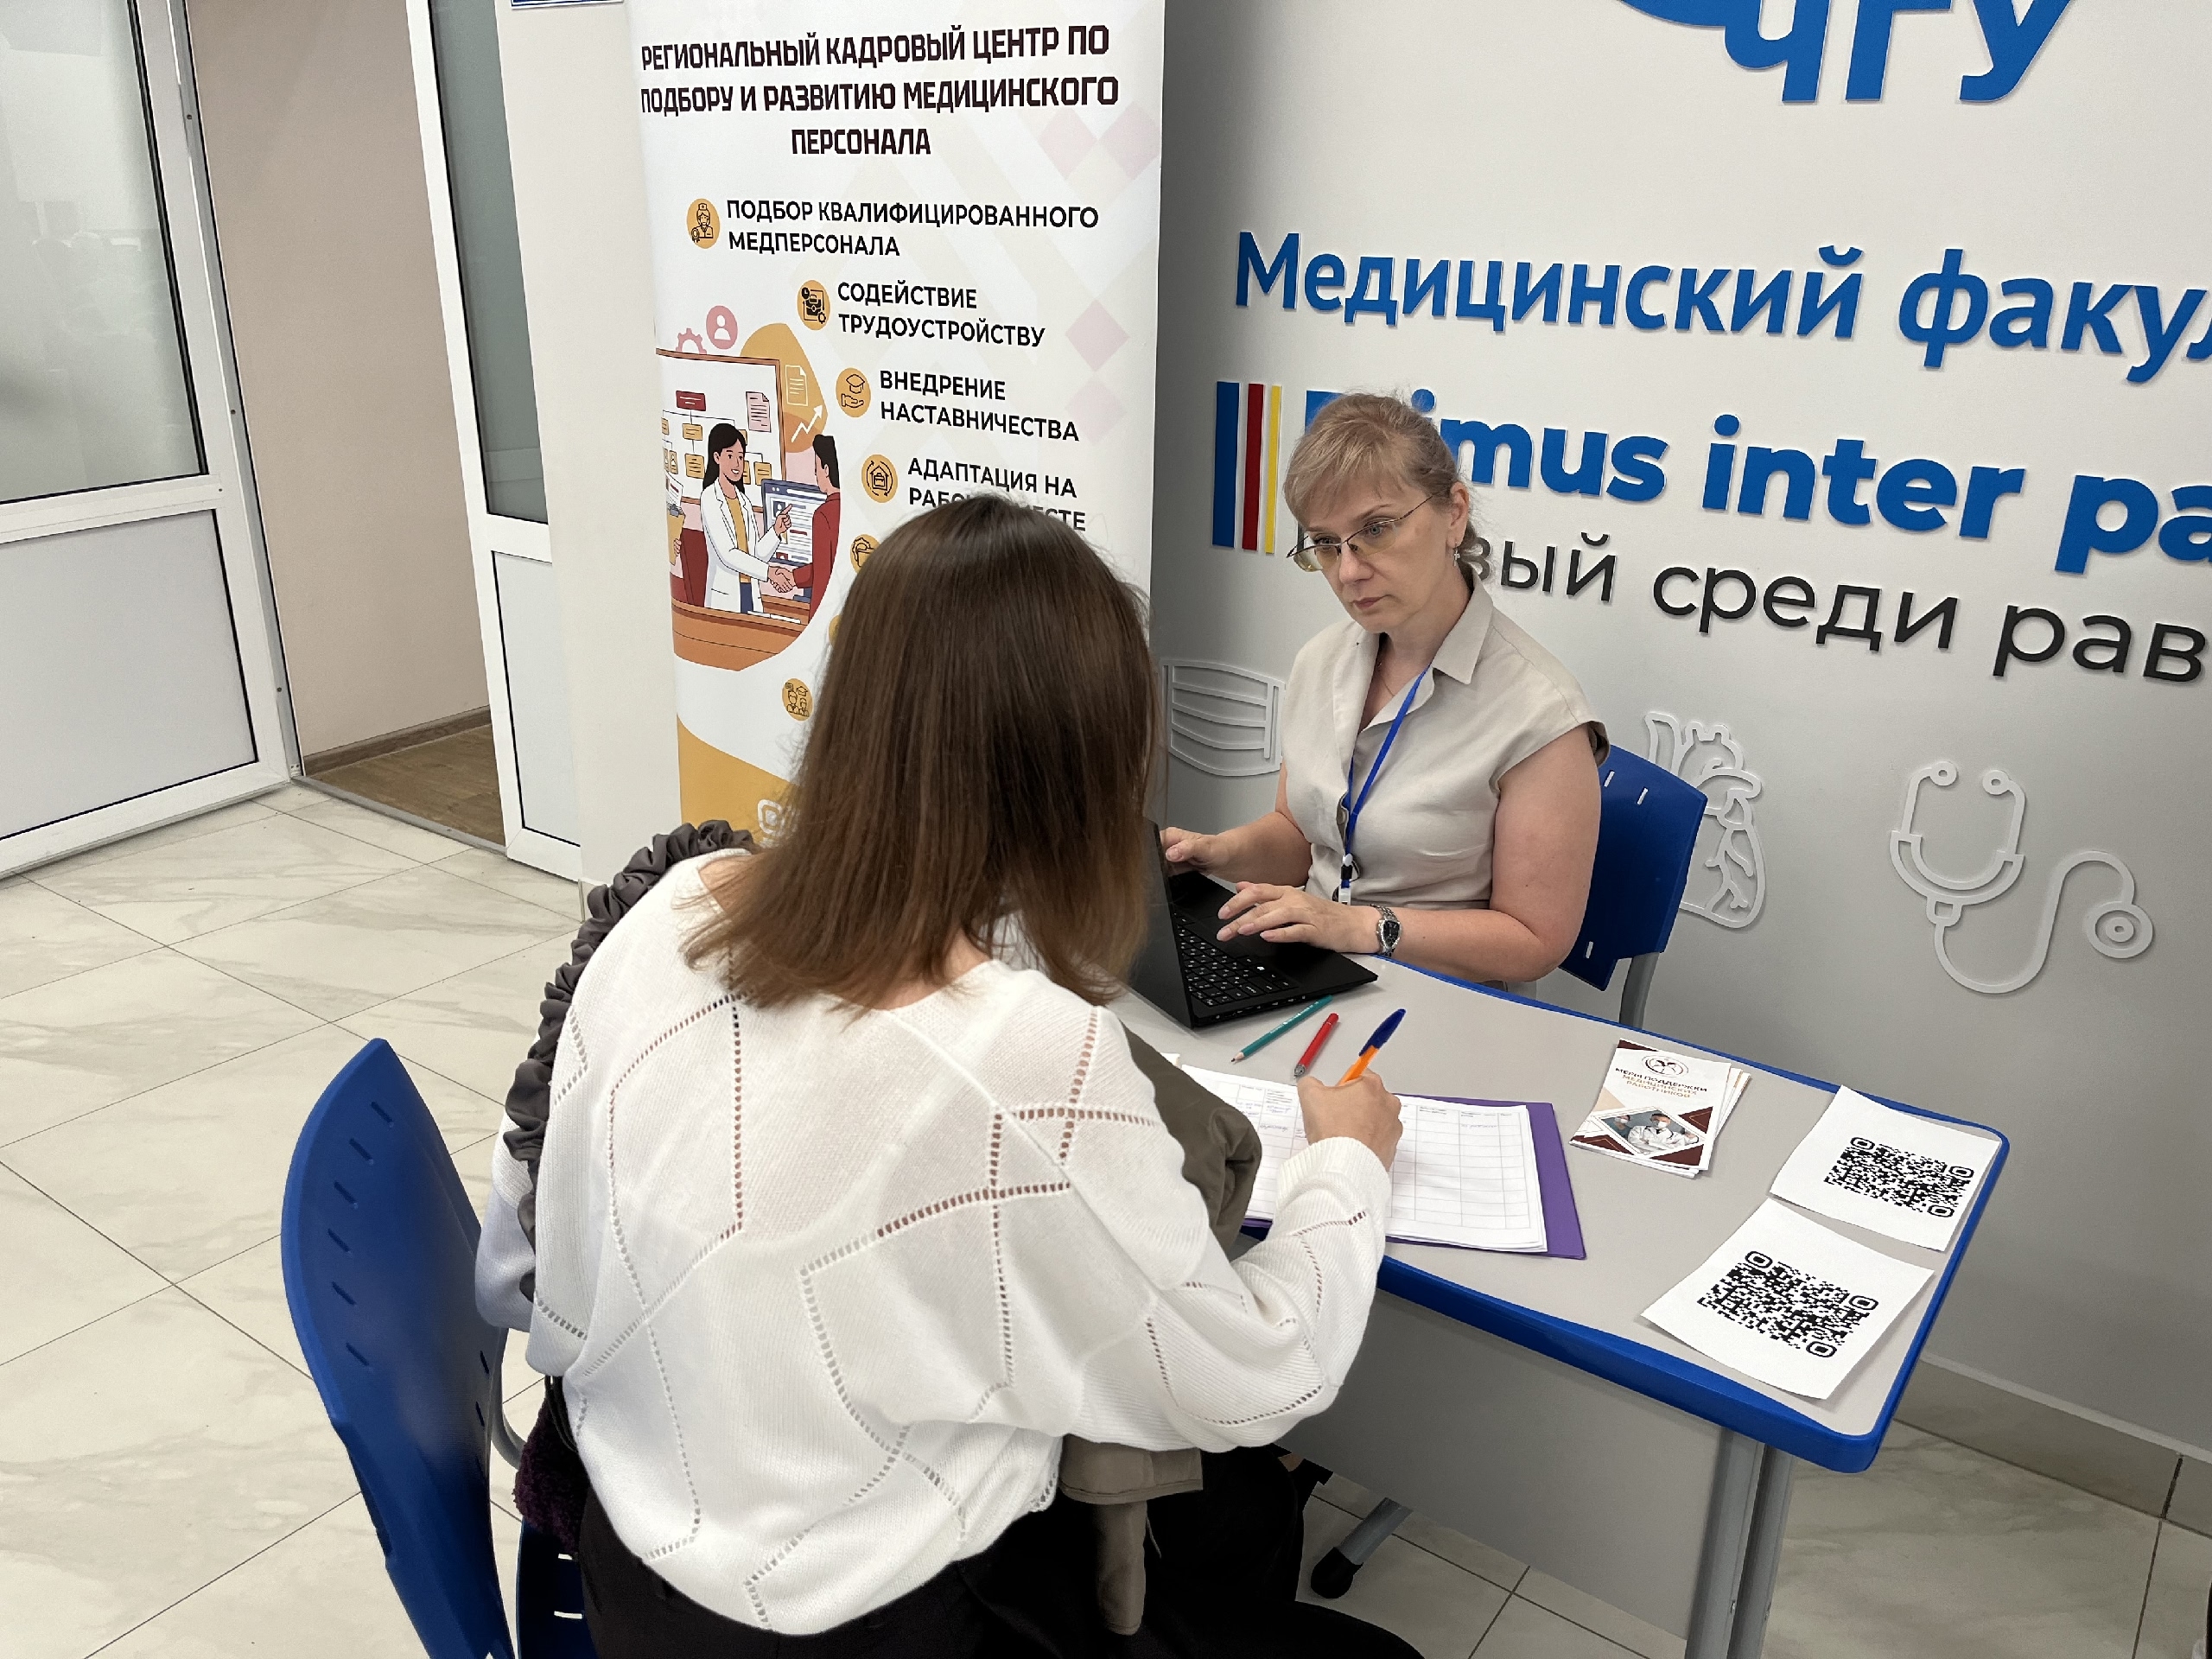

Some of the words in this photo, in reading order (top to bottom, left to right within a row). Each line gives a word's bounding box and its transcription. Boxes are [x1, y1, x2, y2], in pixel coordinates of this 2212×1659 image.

[641, 32, 821, 71] РЕГИОНАЛЬНЫЙ
[826, 25, 965, 69] КАДРОВЫЙ
[973, 26, 1059, 65] ЦЕНТР
[1068, 24, 1109, 56] ПО
[640, 86, 734, 118] ПОДБОРУ
[740, 86, 757, 111] И
[763, 82, 896, 111] РАЗВИТИЮ
[903, 76, 1119, 114] МЕДИЦИНСКОГО
[791, 128, 931, 156] ПЕРСОНАЛА
[727, 200, 813, 223] ПОДБОР
[818, 201, 1099, 228] КВАЛИФИЦИРОВАННОГО
[728, 231, 900, 257] МЕДПЕРСОНАЛА
[837, 280, 977, 309] СОДЕЙСТВИЕ
[1236, 232, 1863, 339] Медицинский
[838, 313, 1046, 347] ТРУДОУСТРОЙСТВУ
[880, 370, 1006, 401] ВНЕДРЕНИЕ
[880, 402, 1079, 442] НАСТАВНИЧЕСТВА
[907, 457, 1037, 493] АДАПТАЦИЯ
[1045, 474, 1077, 499] НА
[1305, 389, 1668, 502] mus
[1702, 413, 2025, 539] inter
[1652, 565, 1959, 653] среди
[1991, 604, 2208, 684] рав
[1622, 1074, 1697, 1096] МЕДИЦИНСКИХ
[1643, 1075, 1707, 1092] ПОДДЕРЖКИ
